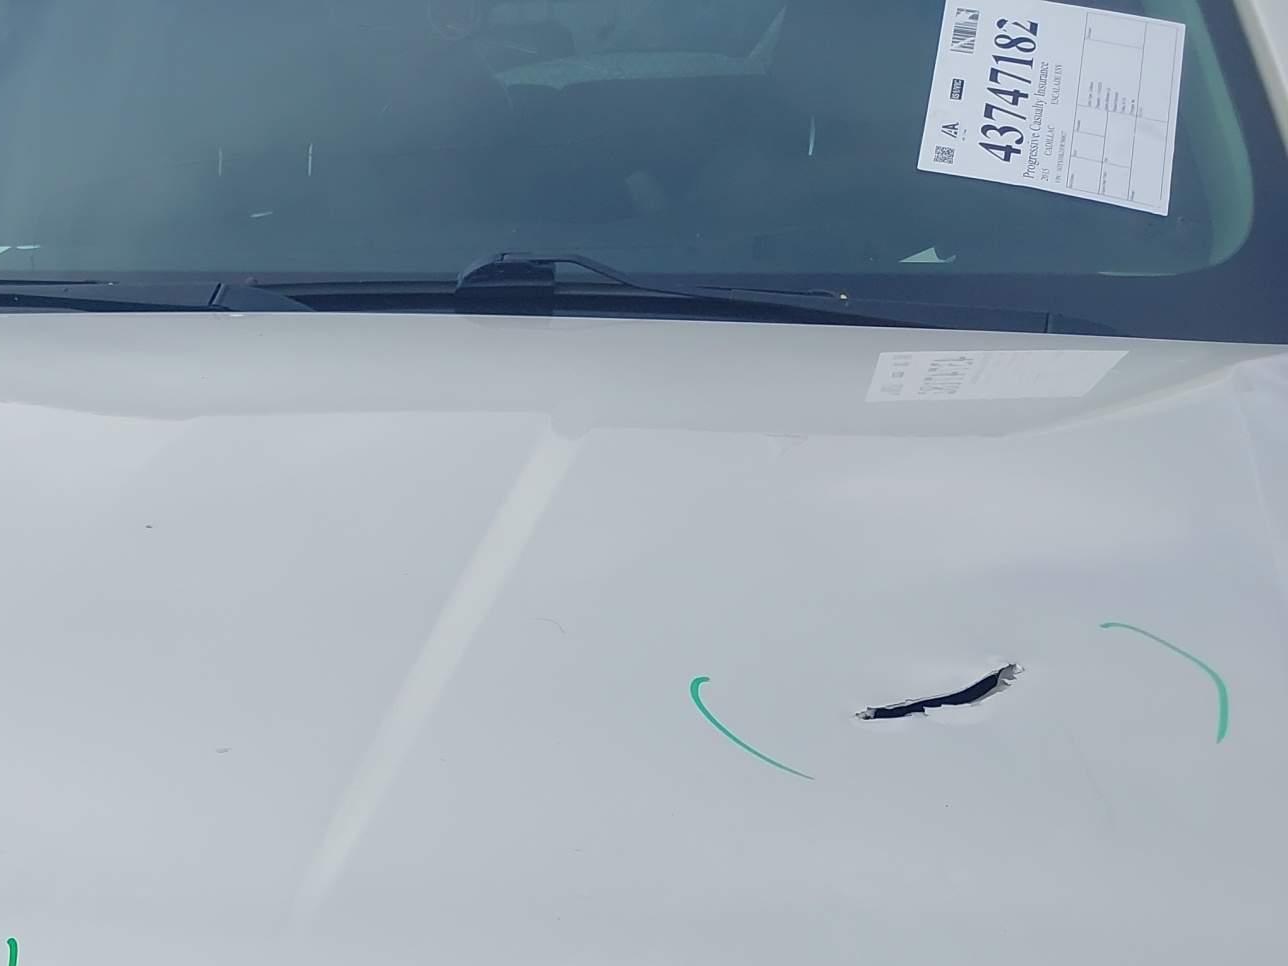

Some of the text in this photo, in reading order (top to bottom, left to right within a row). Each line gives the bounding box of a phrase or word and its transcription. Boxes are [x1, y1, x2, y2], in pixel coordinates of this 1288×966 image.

[978, 18, 1039, 162] 43747182
[1023, 61, 1049, 178] Progressive Casualty Insurance
